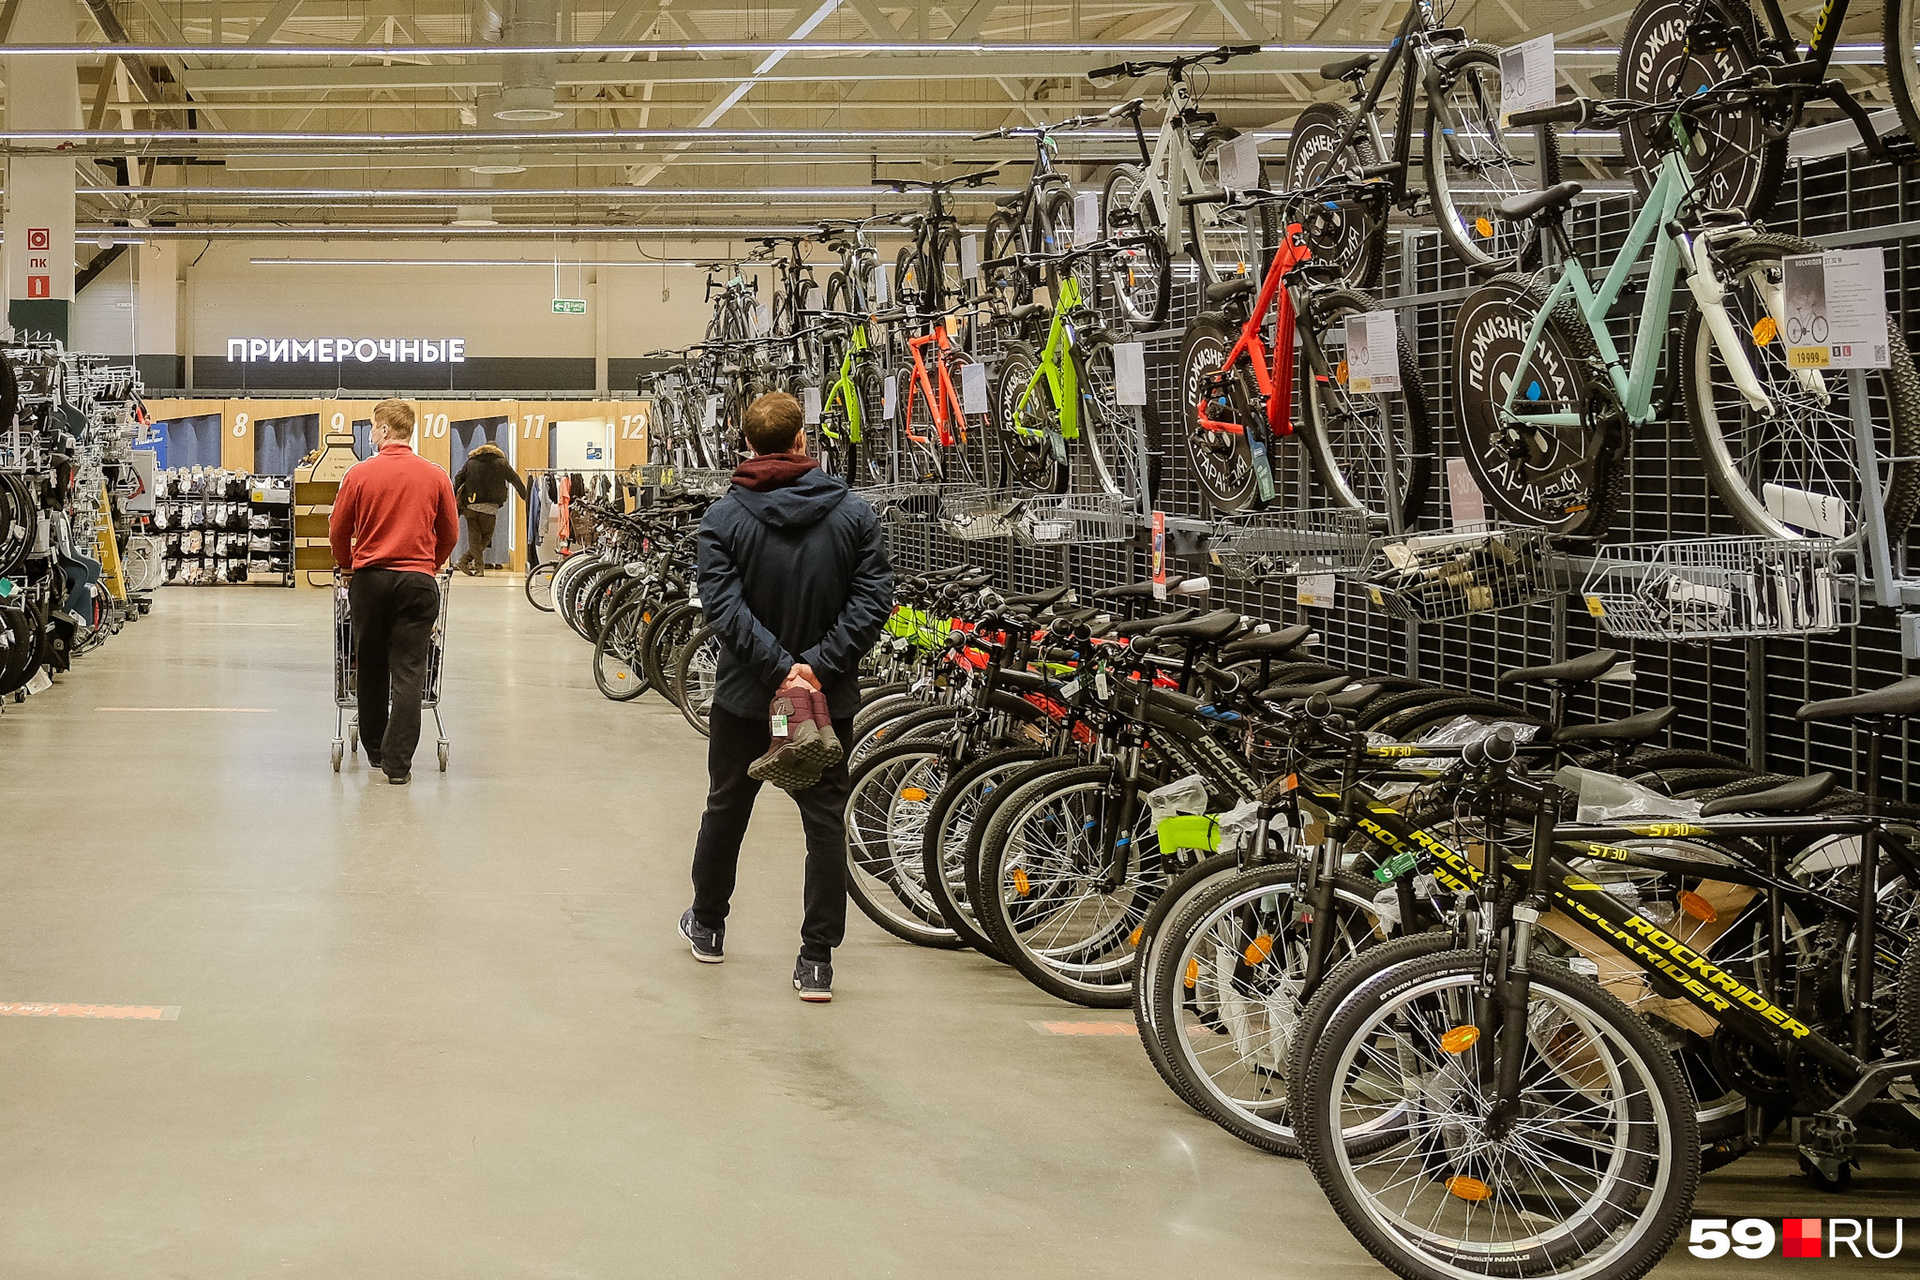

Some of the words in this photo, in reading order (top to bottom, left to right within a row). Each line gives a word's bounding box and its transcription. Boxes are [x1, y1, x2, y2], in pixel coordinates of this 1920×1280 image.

[30, 258, 47, 268] ПК
[227, 338, 465, 363] ПРИМЕРОЧНЫЕ
[1797, 352, 1820, 363] 19999
[233, 412, 249, 437] 8
[331, 412, 345, 433] 9
[423, 413, 449, 438] 10
[522, 414, 545, 439] 11
[621, 414, 646, 440] 12
[1199, 735, 1263, 798] ROCKRI
[1408, 829, 1484, 884] ROCK
[1382, 868, 1393, 879] S
[1623, 915, 1811, 1040] ROCKRIDER
